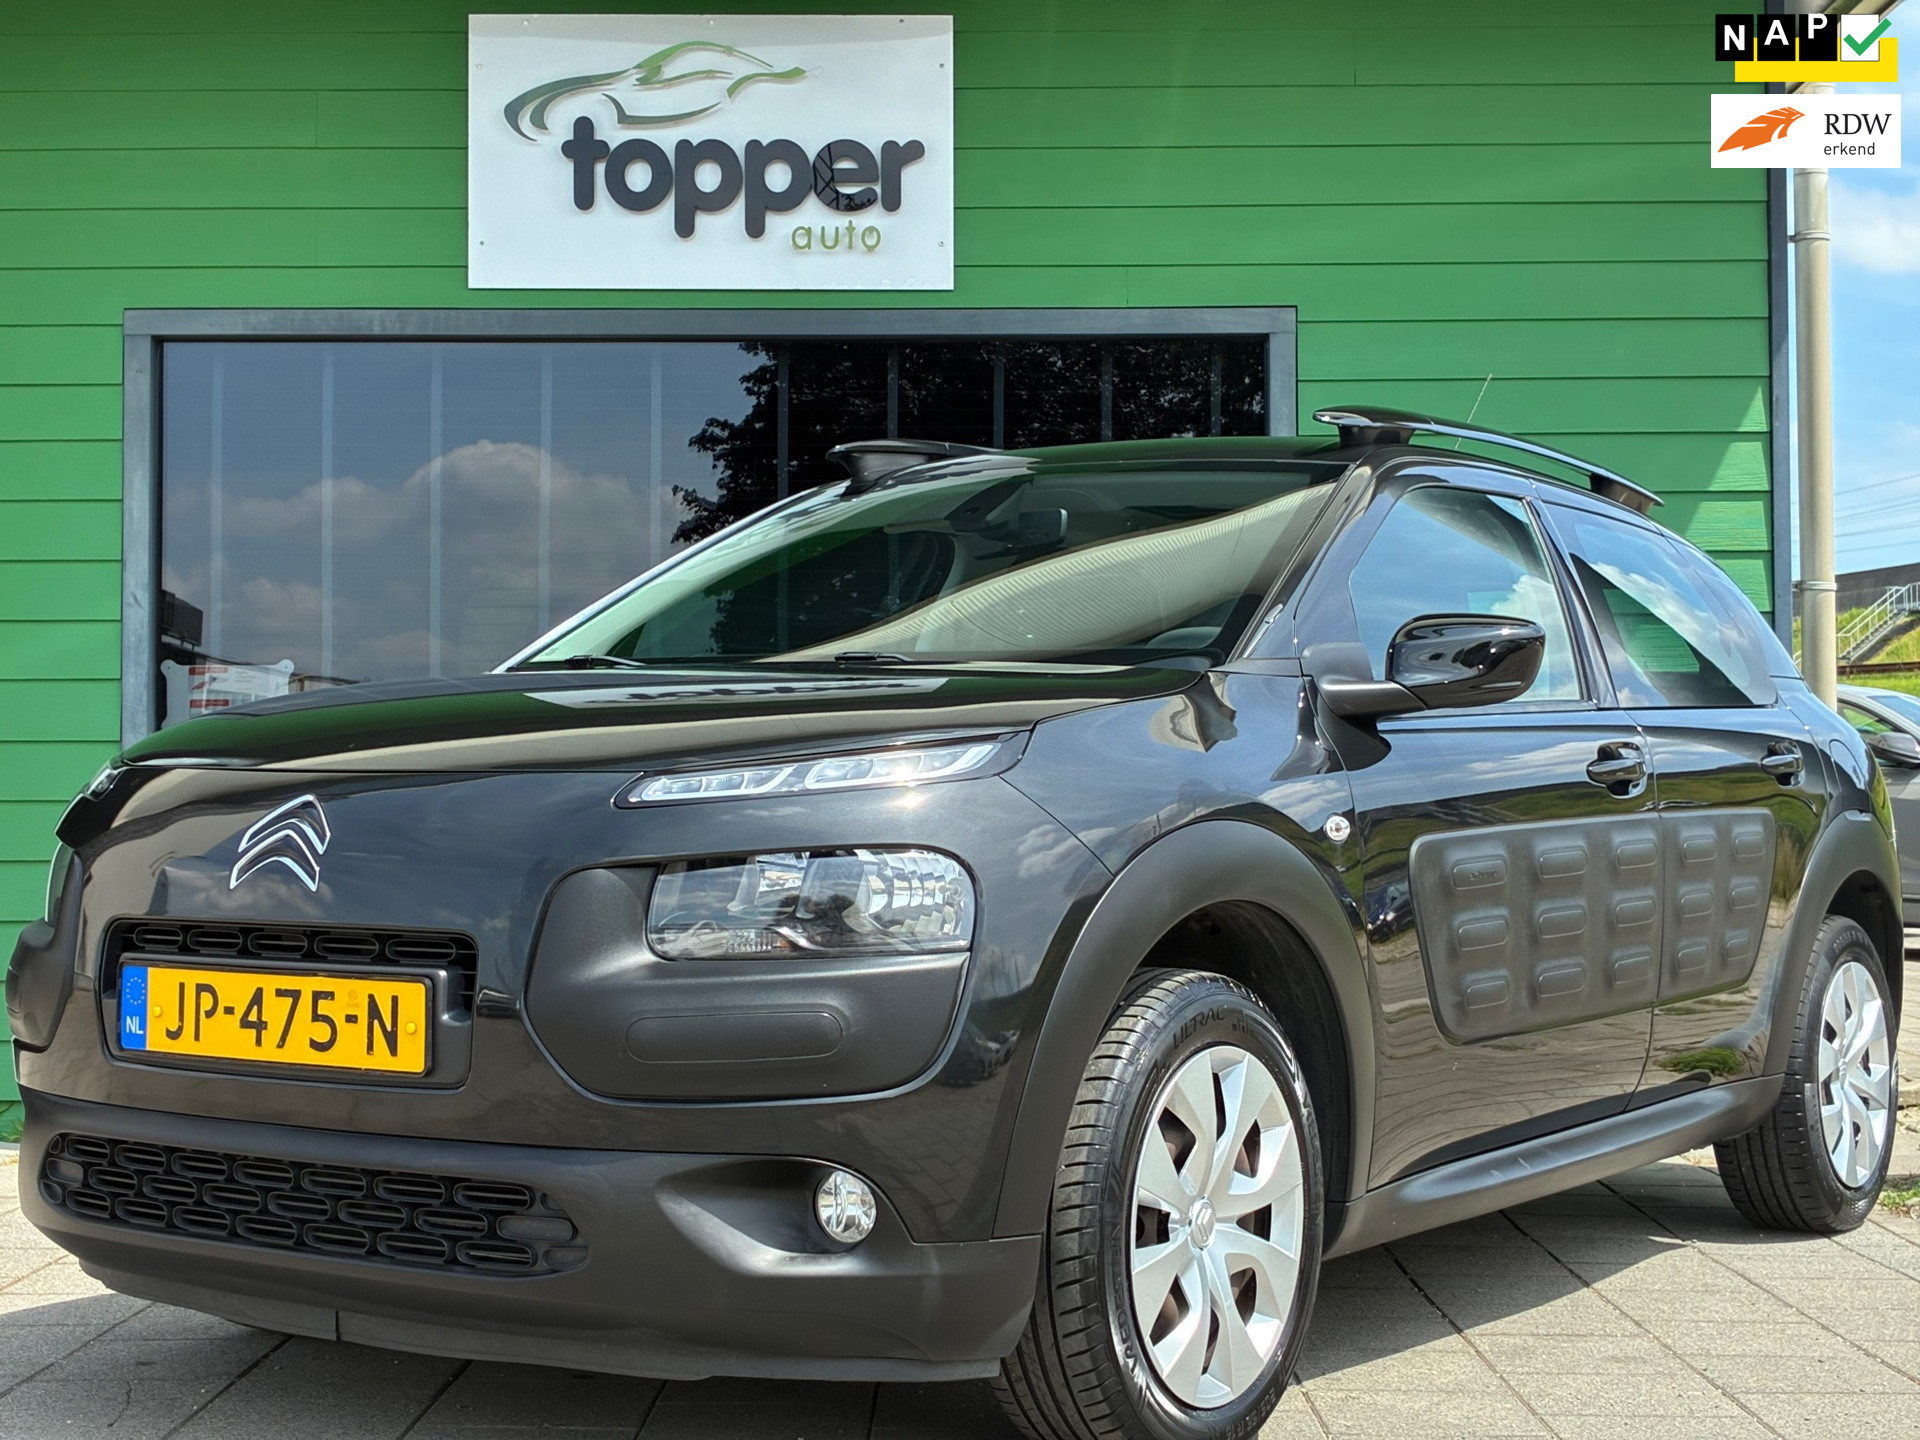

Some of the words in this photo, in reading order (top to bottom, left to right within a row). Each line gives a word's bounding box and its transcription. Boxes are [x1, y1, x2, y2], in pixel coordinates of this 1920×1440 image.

[561, 116, 925, 239] topper
[791, 220, 882, 251] auto
[126, 1016, 144, 1035] NL
[165, 982, 399, 1058] JP-475-N
[1173, 1005, 1226, 1050] ULTRAC
